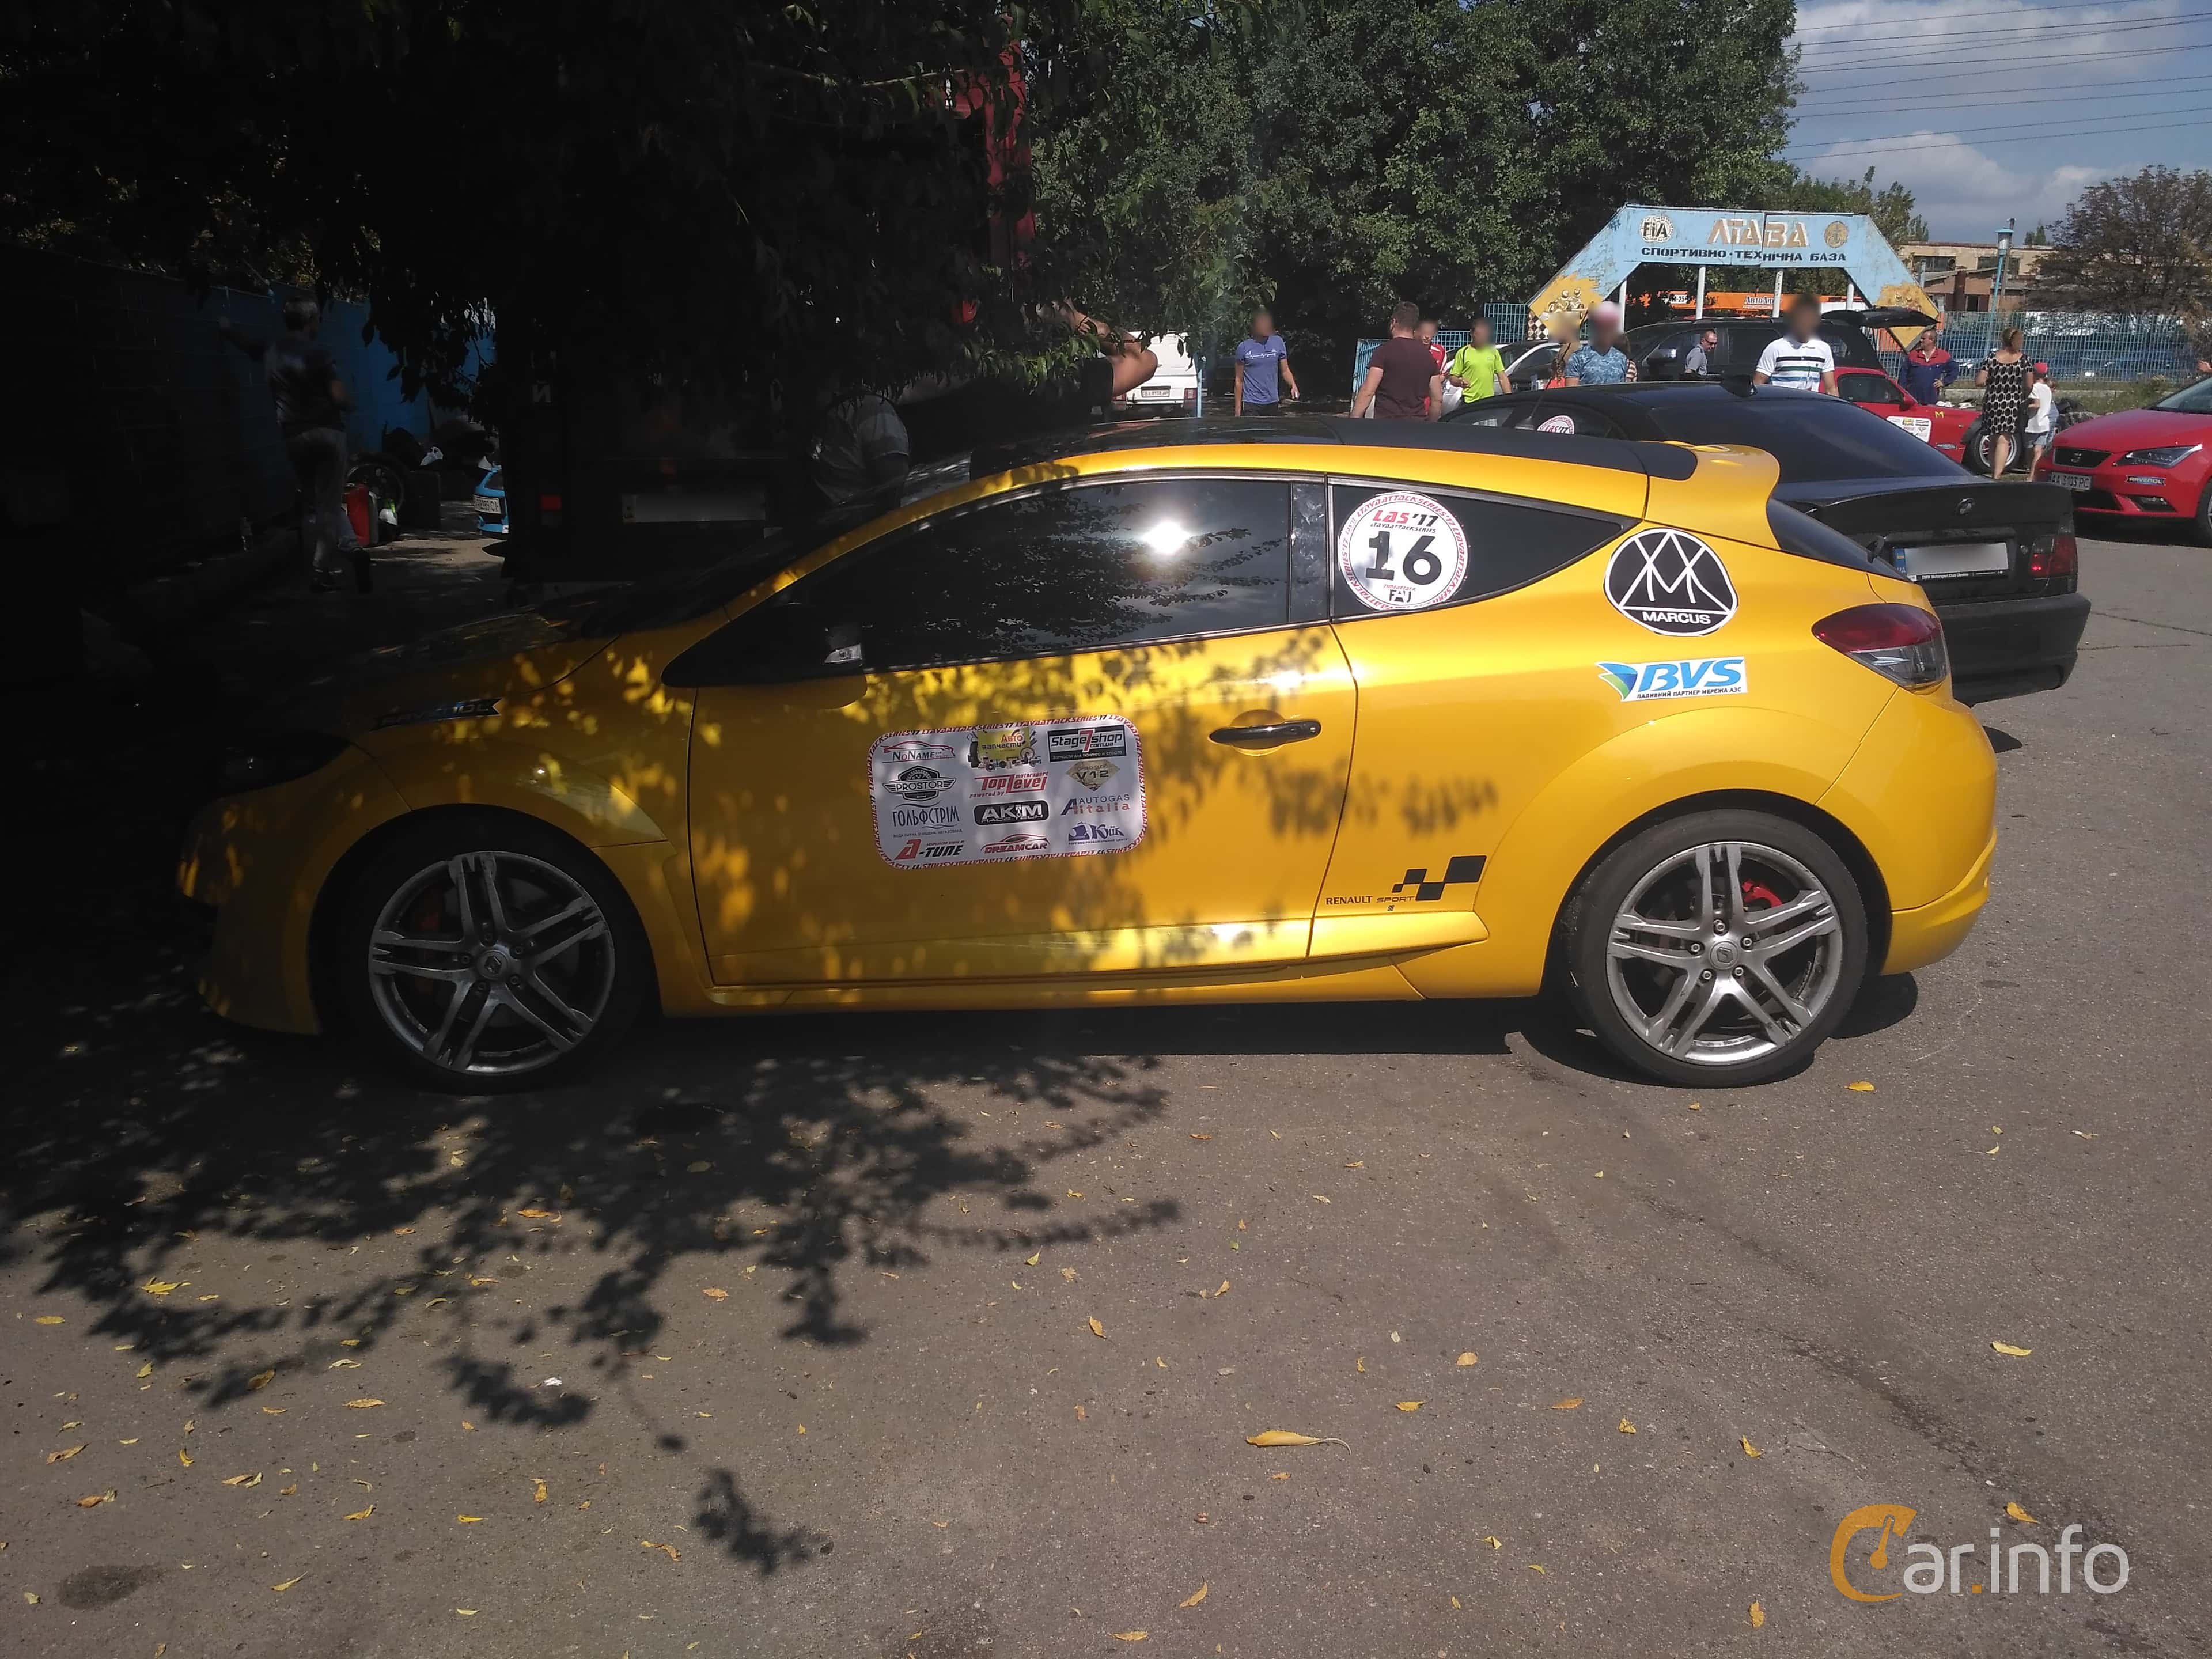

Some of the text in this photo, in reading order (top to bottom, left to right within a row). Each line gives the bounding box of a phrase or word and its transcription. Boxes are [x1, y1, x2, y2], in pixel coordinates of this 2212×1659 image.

[1810, 253, 1846, 262] БАЗА
[1365, 531, 1442, 585] 16
[1642, 611, 1711, 624] MARCUS
[1638, 659, 1744, 692] BVS
[1076, 770, 1109, 779] V12
[896, 781, 944, 791] PROSTOR
[1080, 794, 1130, 804] AUTOGAS
[892, 806, 960, 827] ГОЛЬФСТРІМ
[984, 843, 1048, 854] DREAMCAR
[1326, 895, 1373, 905] RENAULT
